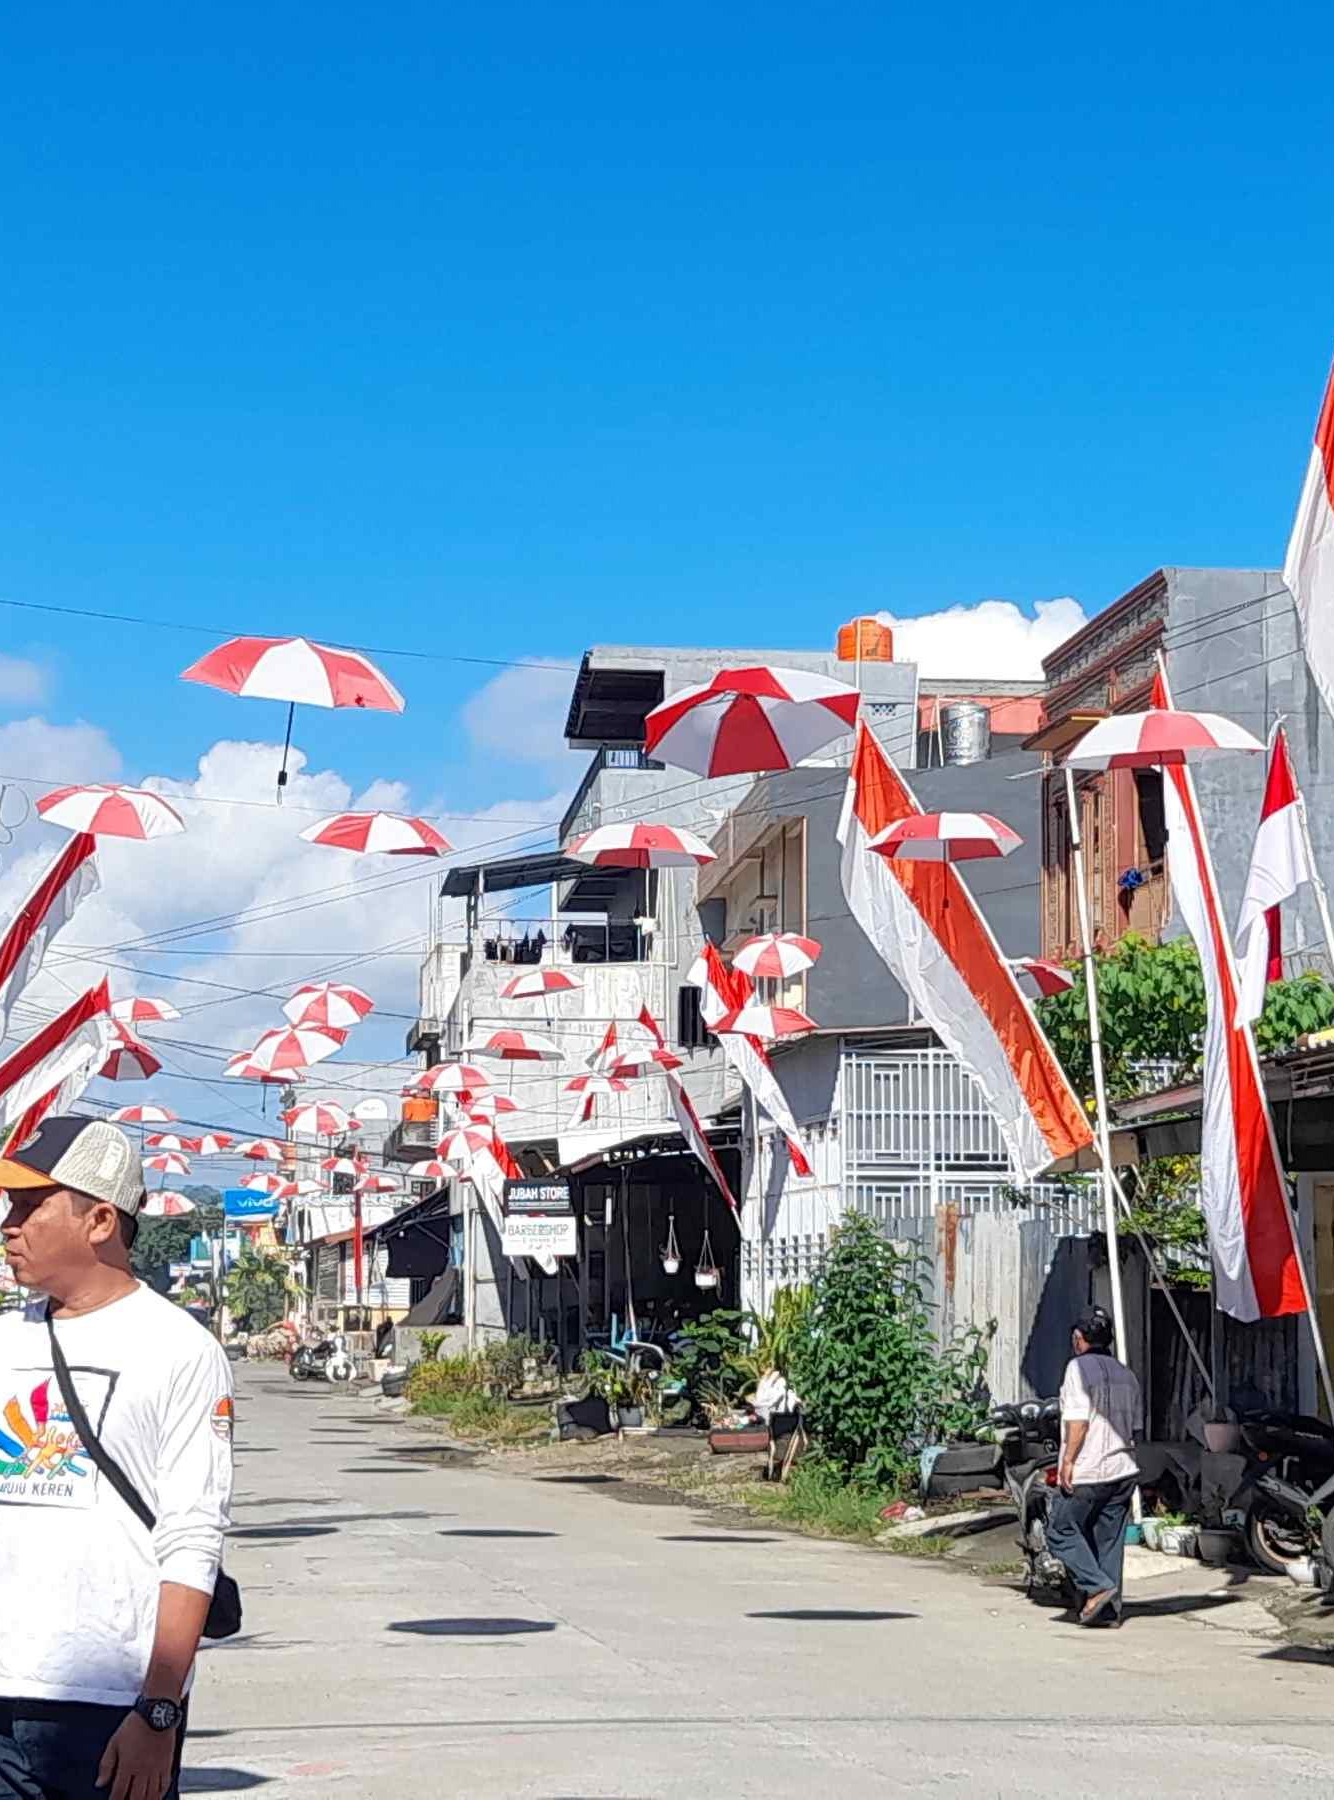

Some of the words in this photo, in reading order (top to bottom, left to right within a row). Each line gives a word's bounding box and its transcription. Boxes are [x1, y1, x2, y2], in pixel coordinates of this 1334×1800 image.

[508, 1186, 538, 1200] JUBAH
[539, 1186, 570, 1200] STORE
[236, 1196, 274, 1208] vivo
[508, 1223, 569, 1236] BARBERSHOP
[31, 1482, 74, 1497] KEREN
